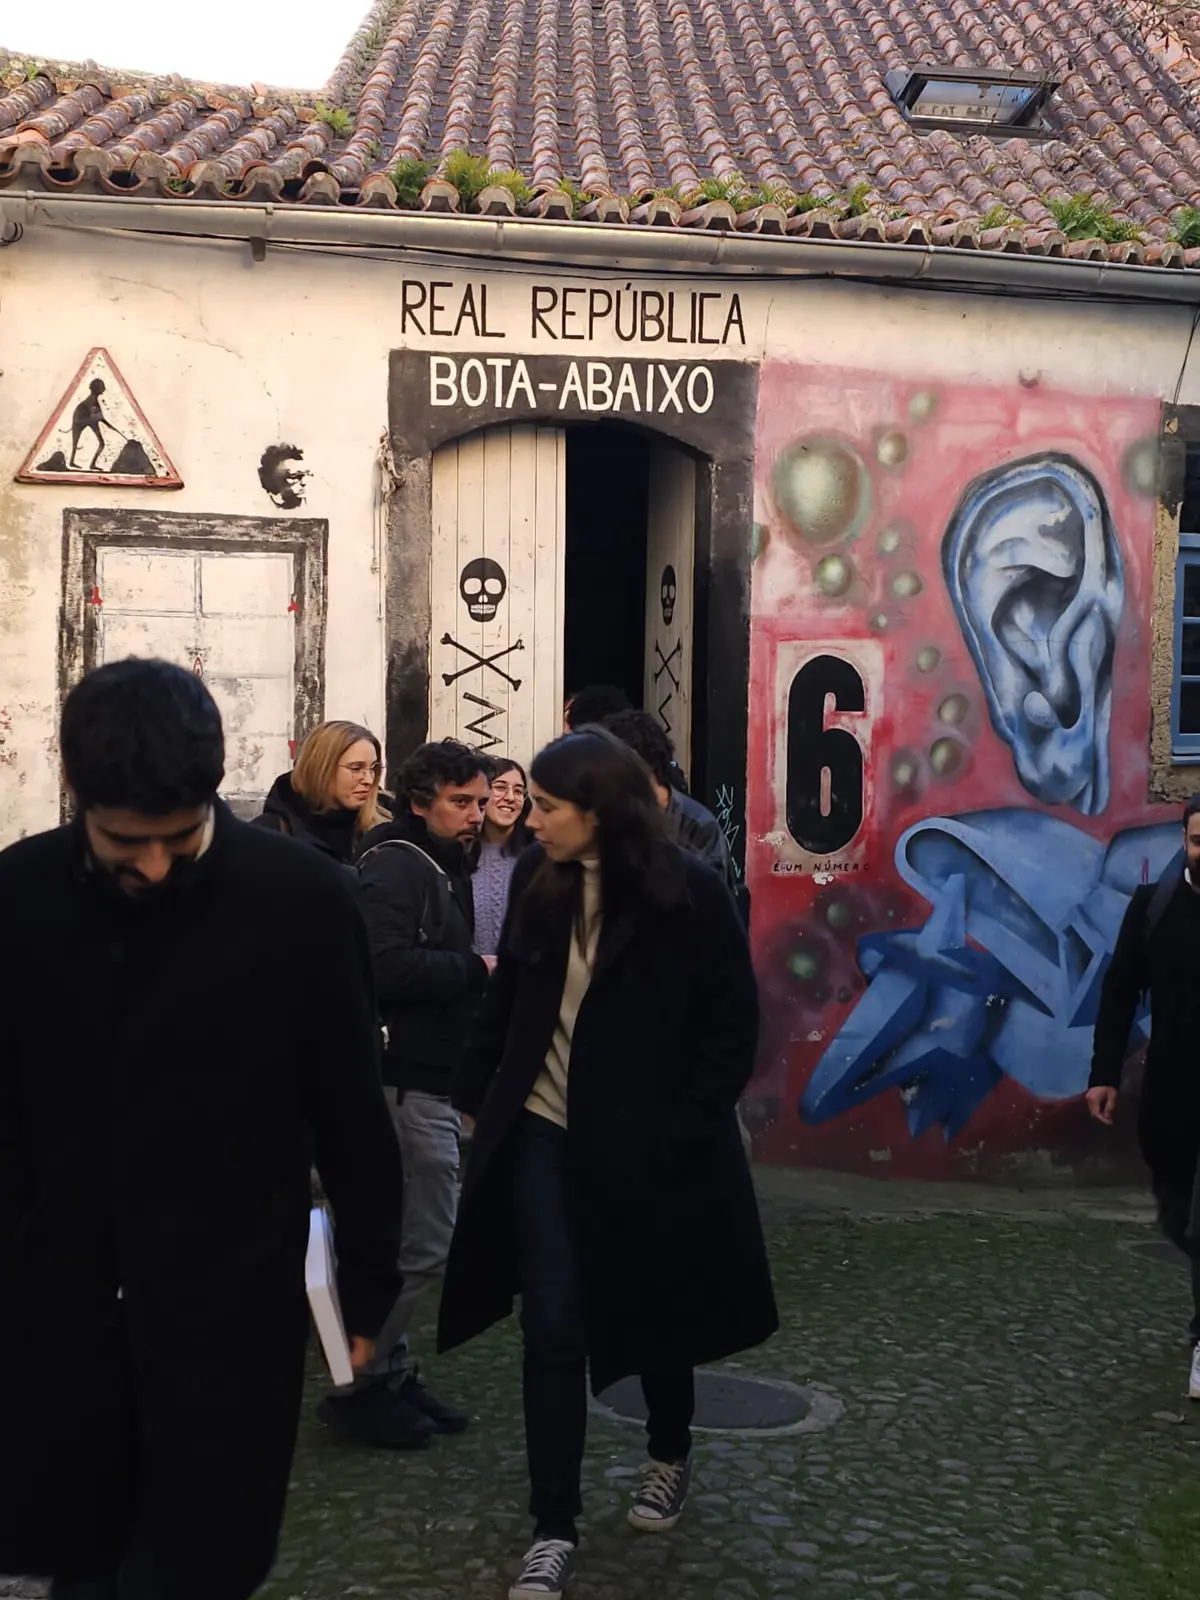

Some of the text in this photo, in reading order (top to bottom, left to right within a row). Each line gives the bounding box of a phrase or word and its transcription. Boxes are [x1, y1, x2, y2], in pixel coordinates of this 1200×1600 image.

[400, 279, 746, 345] REAL REPÚBLICA
[429, 355, 714, 414] BOTA-ABAIXO
[786, 654, 866, 855] 6
[813, 859, 870, 872] NÚMERO
